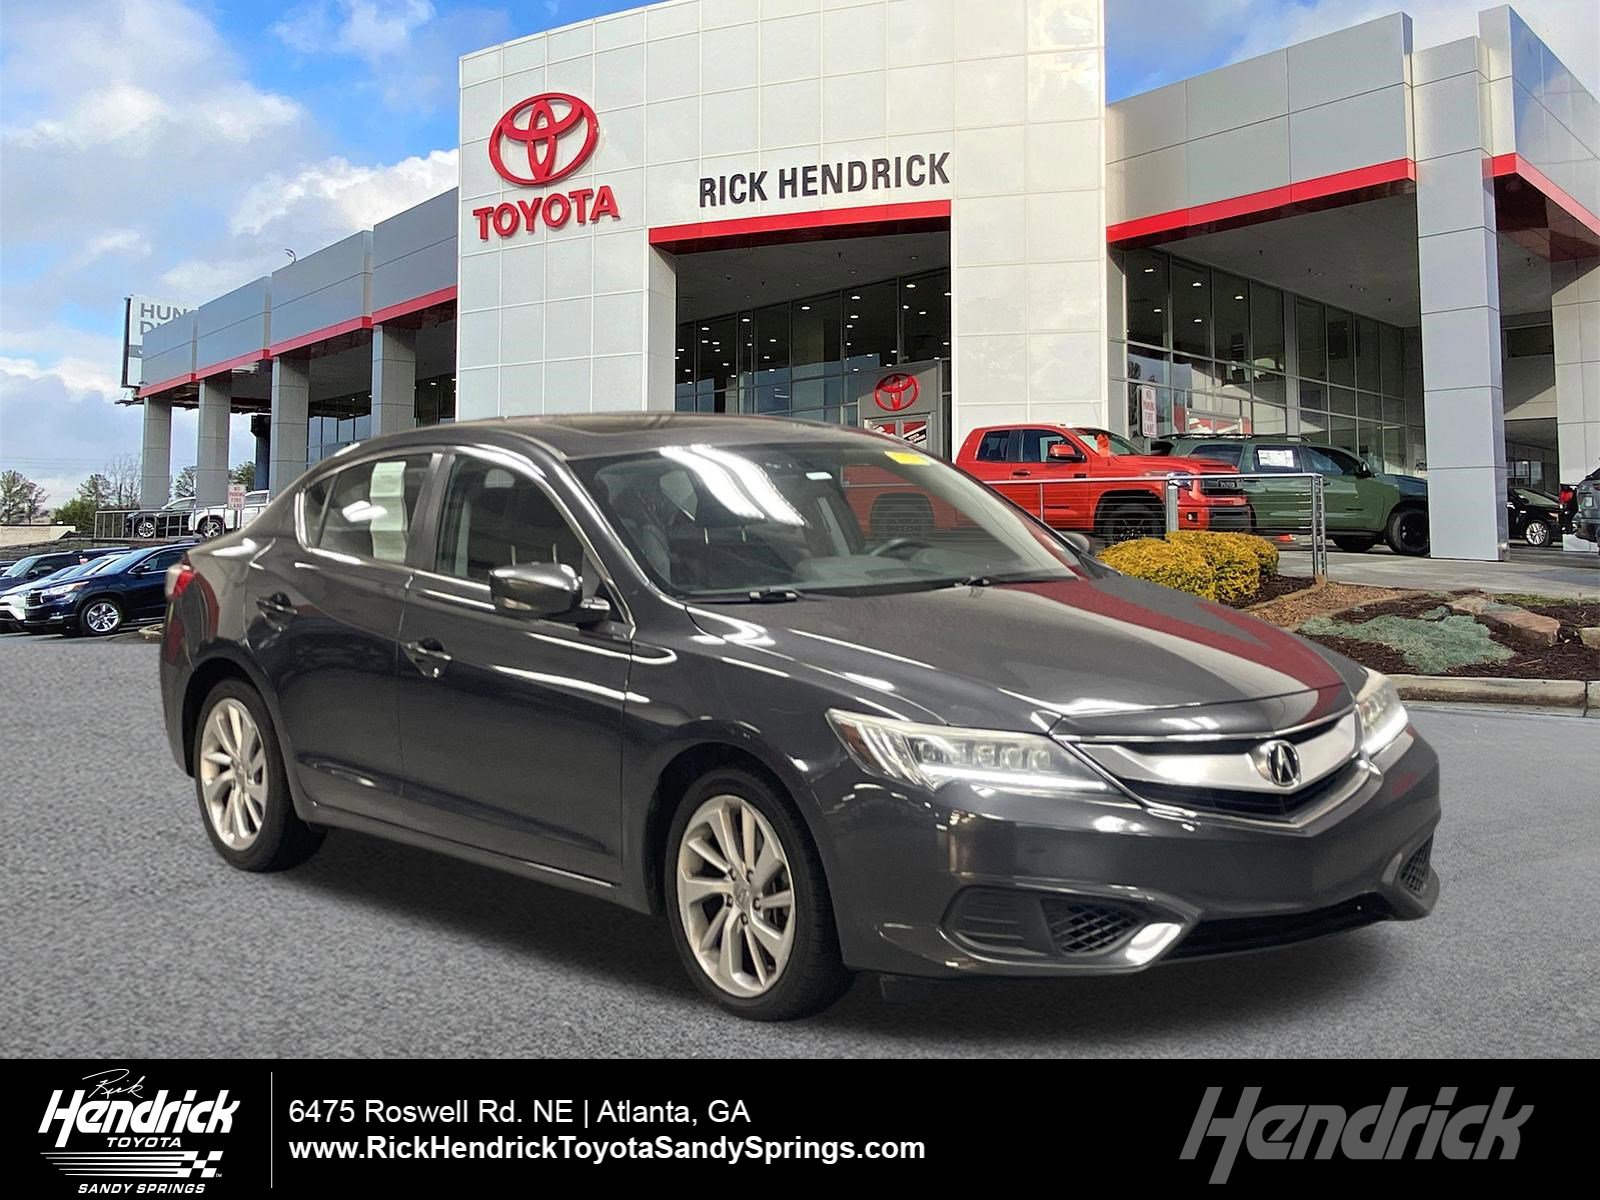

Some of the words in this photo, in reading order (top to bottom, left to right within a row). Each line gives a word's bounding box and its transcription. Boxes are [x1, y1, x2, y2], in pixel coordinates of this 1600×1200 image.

[699, 170, 768, 208] RICK
[778, 152, 951, 200] HENDRICK
[472, 185, 621, 241] TOYOTA
